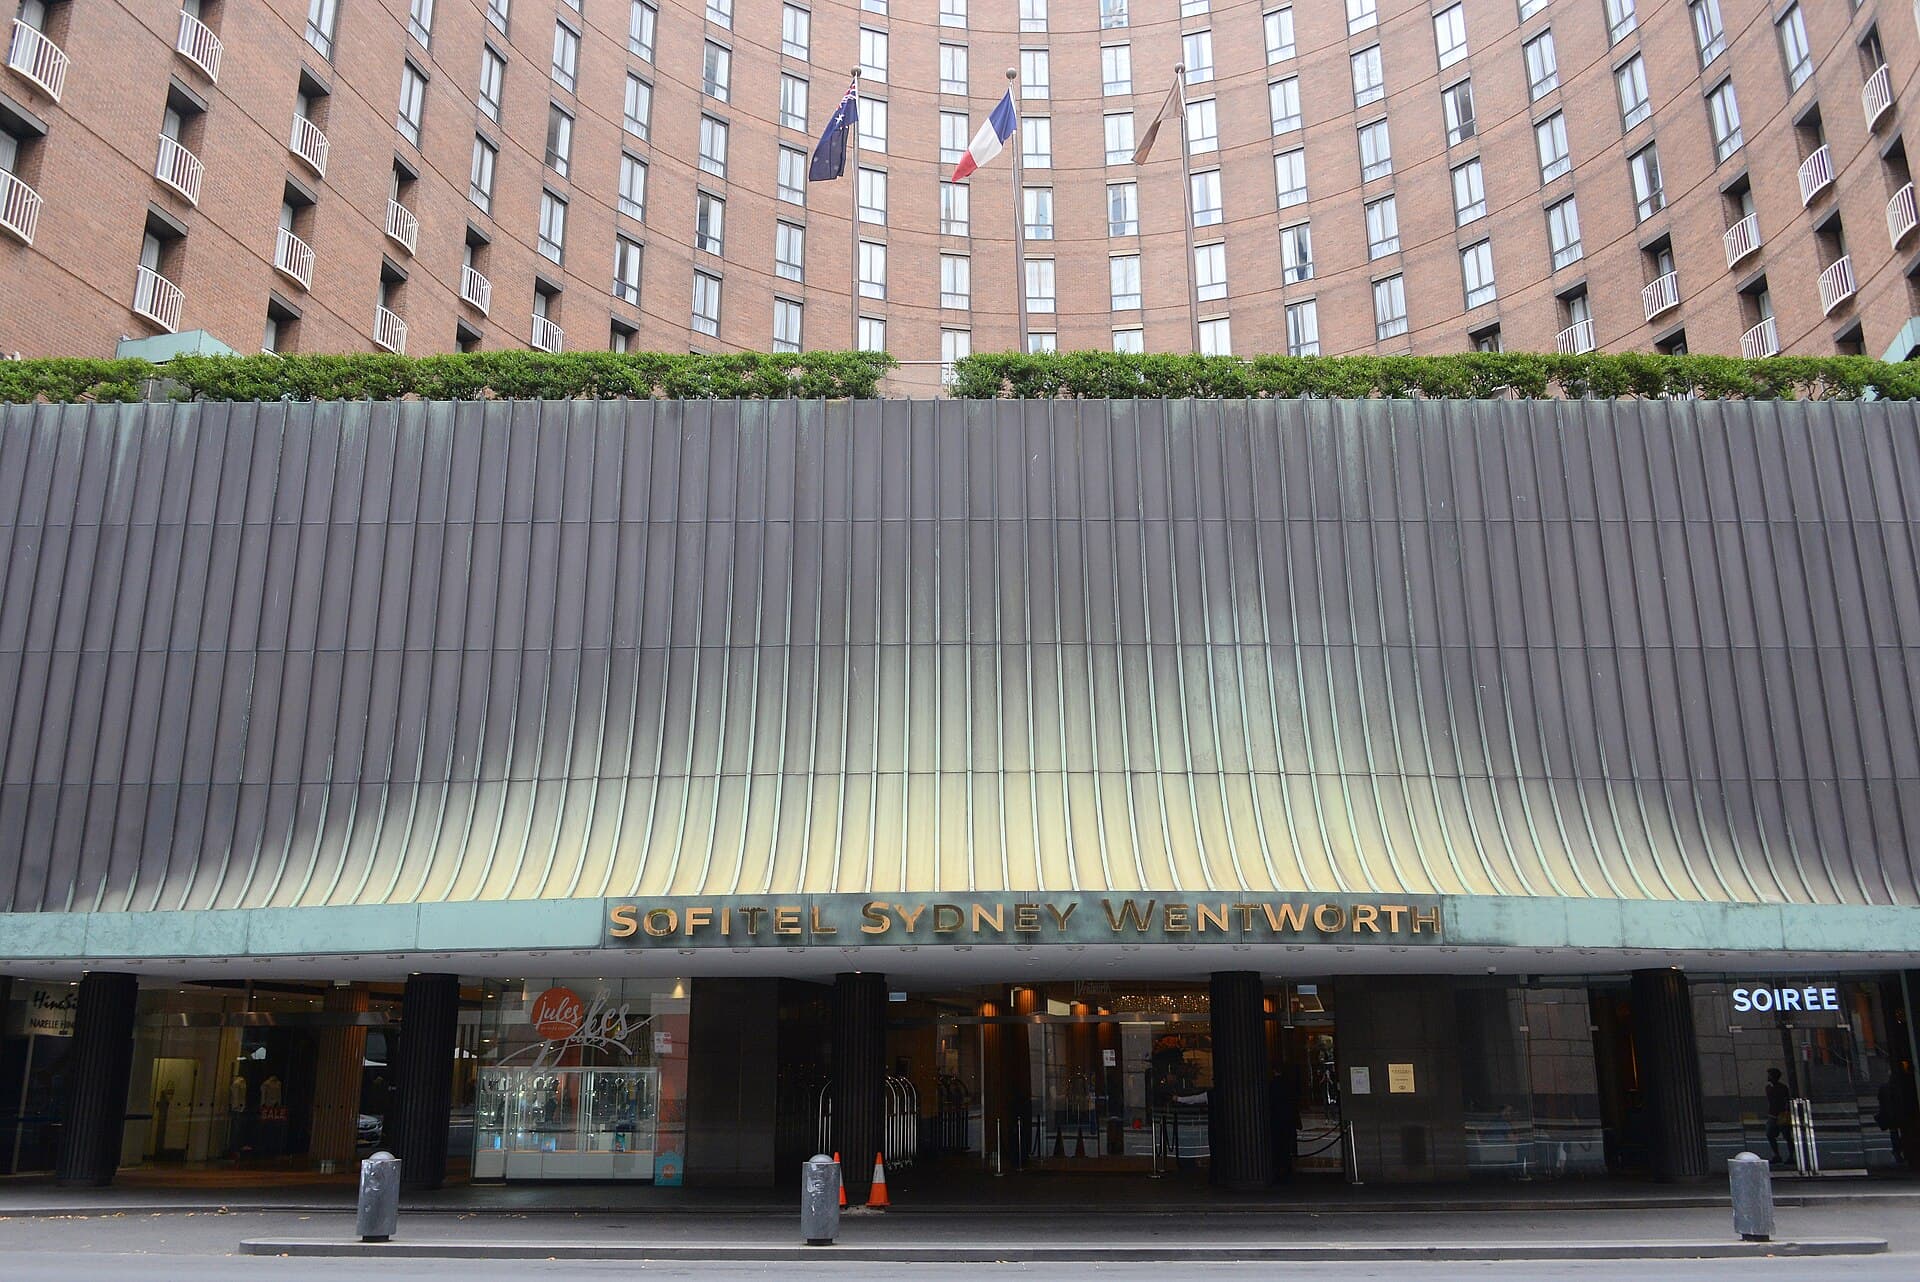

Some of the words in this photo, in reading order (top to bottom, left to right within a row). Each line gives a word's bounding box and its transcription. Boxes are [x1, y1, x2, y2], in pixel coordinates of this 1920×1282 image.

[609, 903, 837, 938] SOFITEL
[860, 900, 1079, 935] SYDNEY
[1102, 898, 1441, 935] WENTWORTH
[1732, 985, 1840, 1012] SOIRÉE
[30, 1018, 58, 1029] NARELLE
[533, 995, 583, 1031] jules
[261, 1107, 286, 1120] SALE
